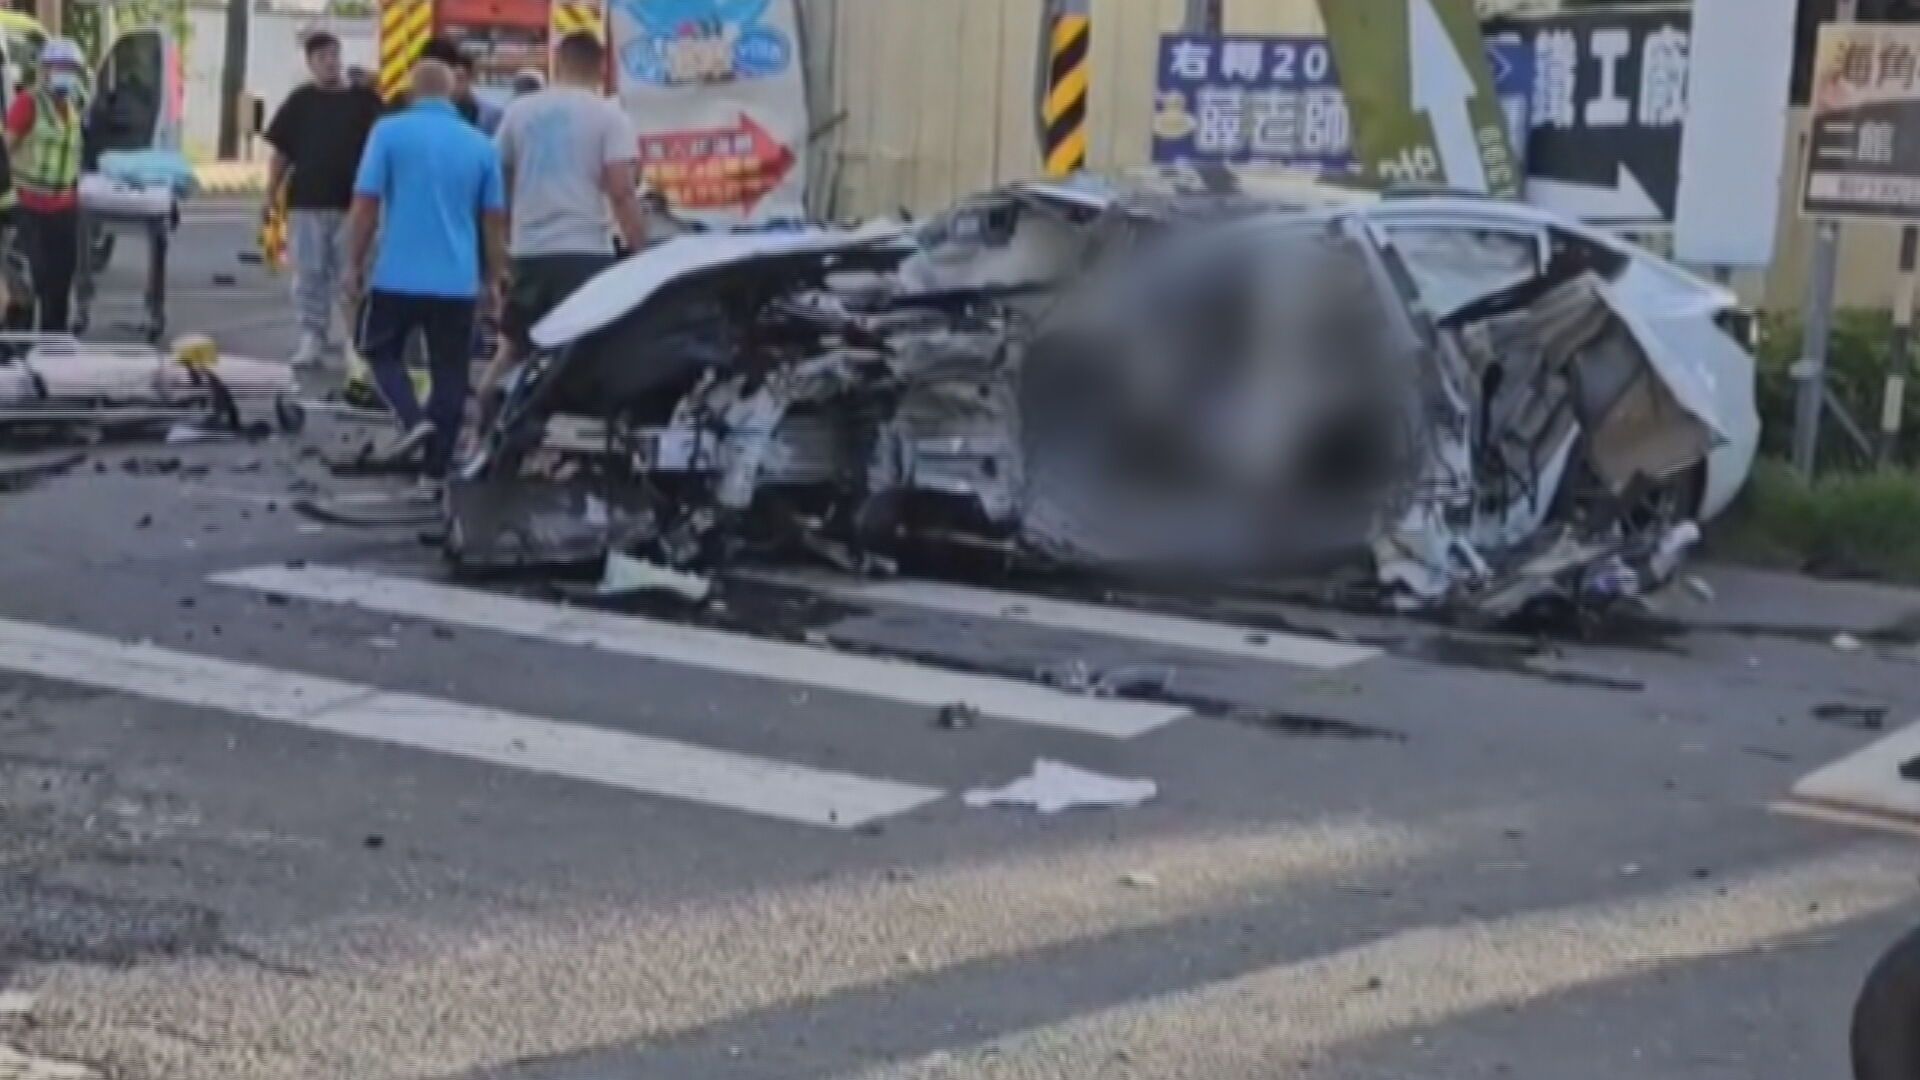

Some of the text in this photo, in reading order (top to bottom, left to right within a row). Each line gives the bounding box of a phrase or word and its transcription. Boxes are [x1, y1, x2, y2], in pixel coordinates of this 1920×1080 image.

[1488, 26, 1690, 128] 鐵工廠
[1836, 42, 1920, 90] 海角
